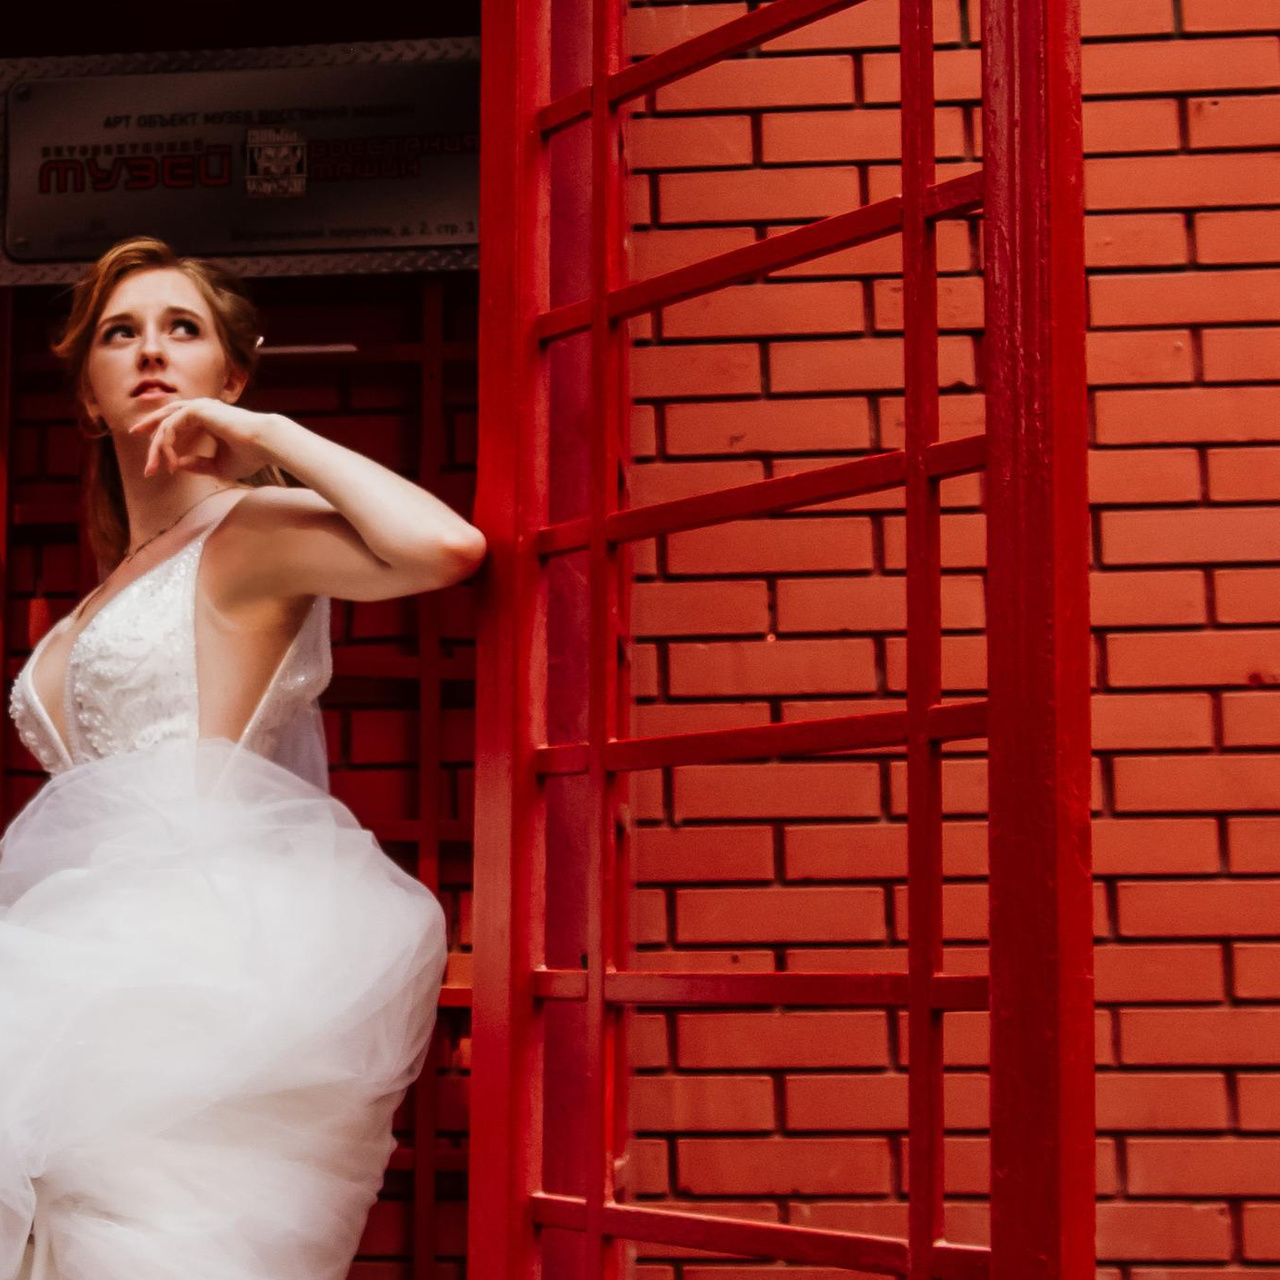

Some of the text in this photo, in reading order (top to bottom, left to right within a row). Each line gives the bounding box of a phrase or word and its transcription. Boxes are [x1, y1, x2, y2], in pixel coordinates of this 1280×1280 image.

[103, 114, 131, 129] АРТ
[136, 111, 197, 128] ОБЪЕКТ
[39, 144, 233, 194] МУЗЕЙ
